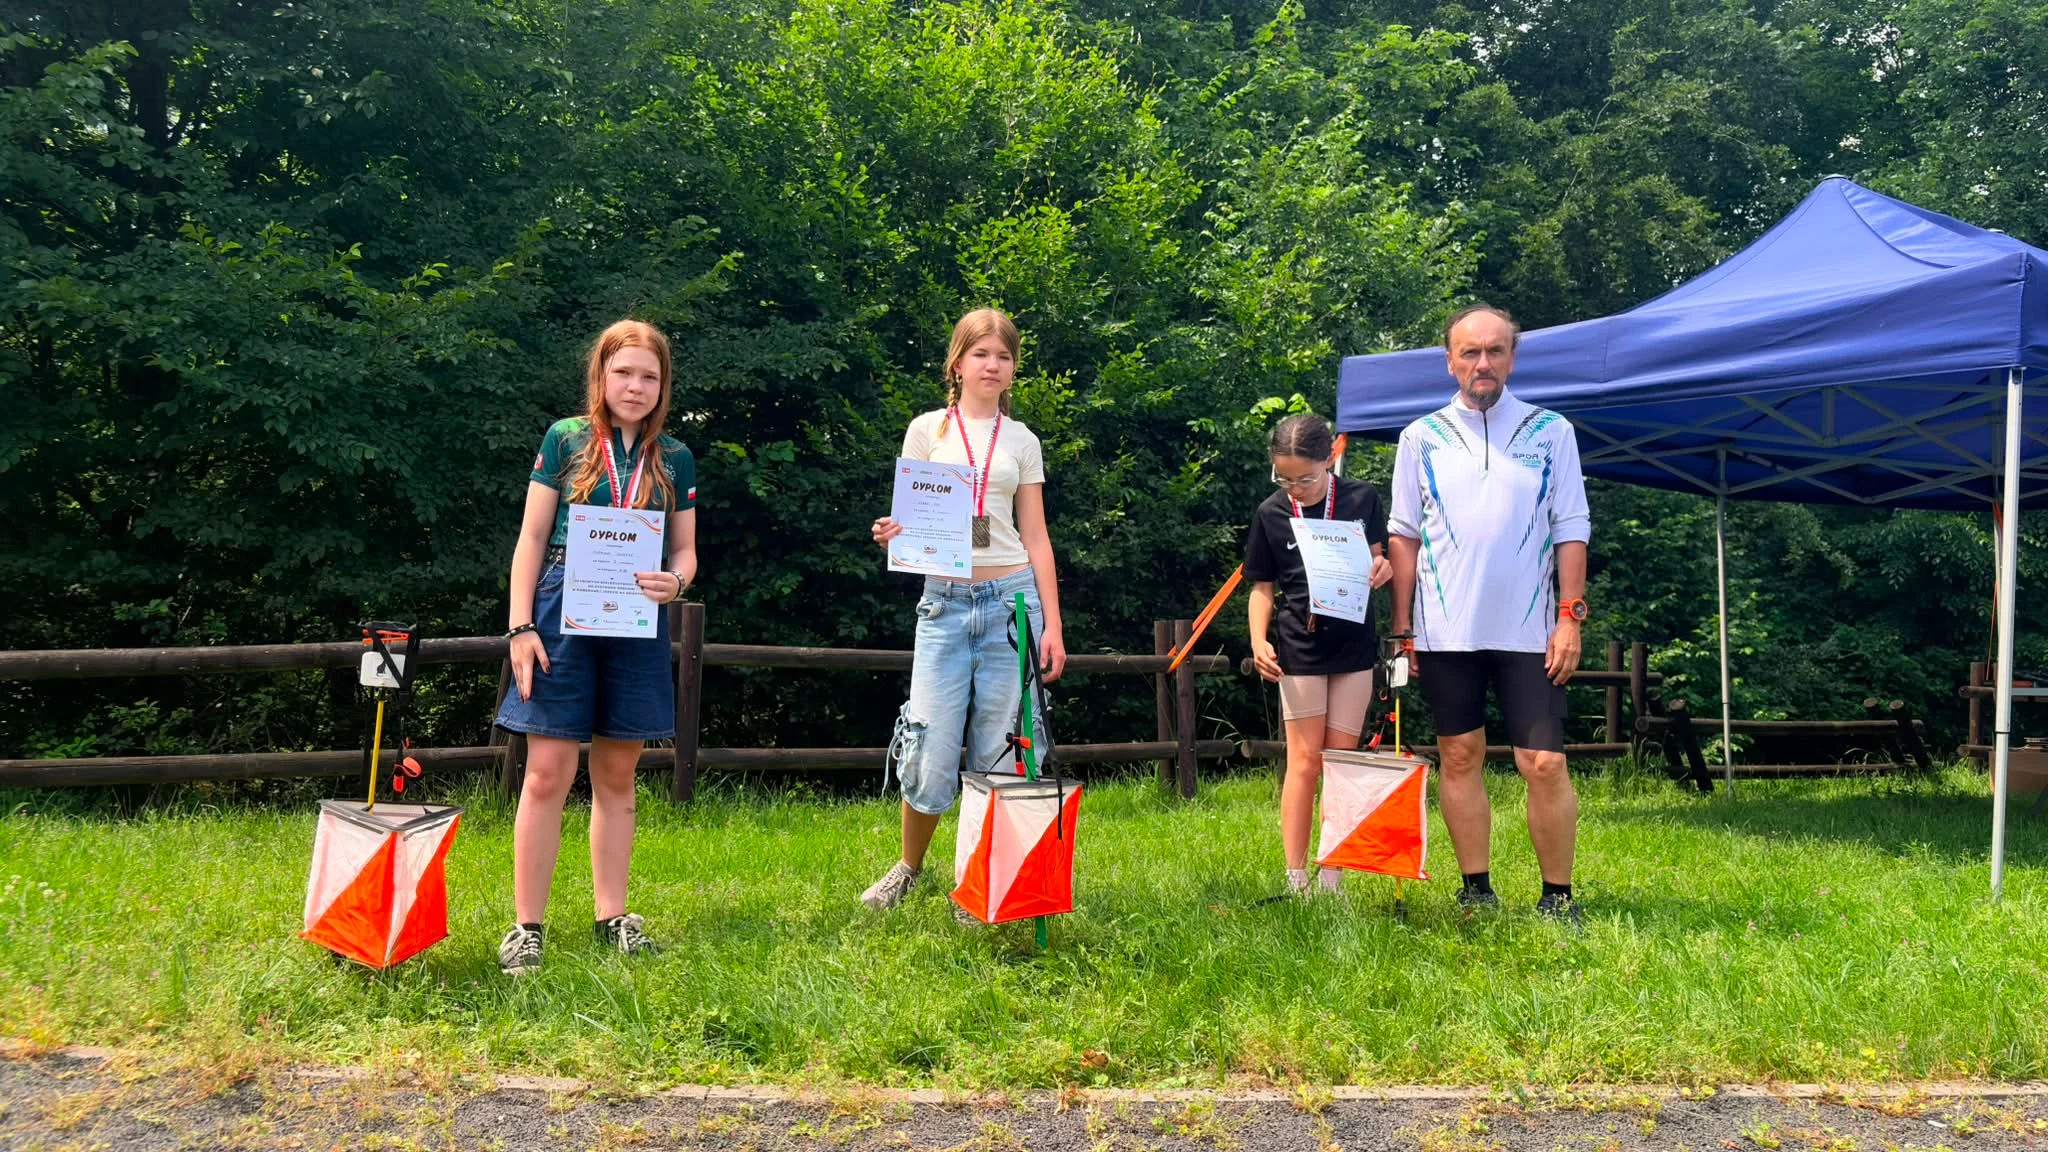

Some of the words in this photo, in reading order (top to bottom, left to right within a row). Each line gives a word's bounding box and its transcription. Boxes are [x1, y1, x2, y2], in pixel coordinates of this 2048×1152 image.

[912, 481, 953, 494] DYPLOM
[589, 529, 637, 542] DYPLOM
[1312, 534, 1348, 543] DYPLOM
